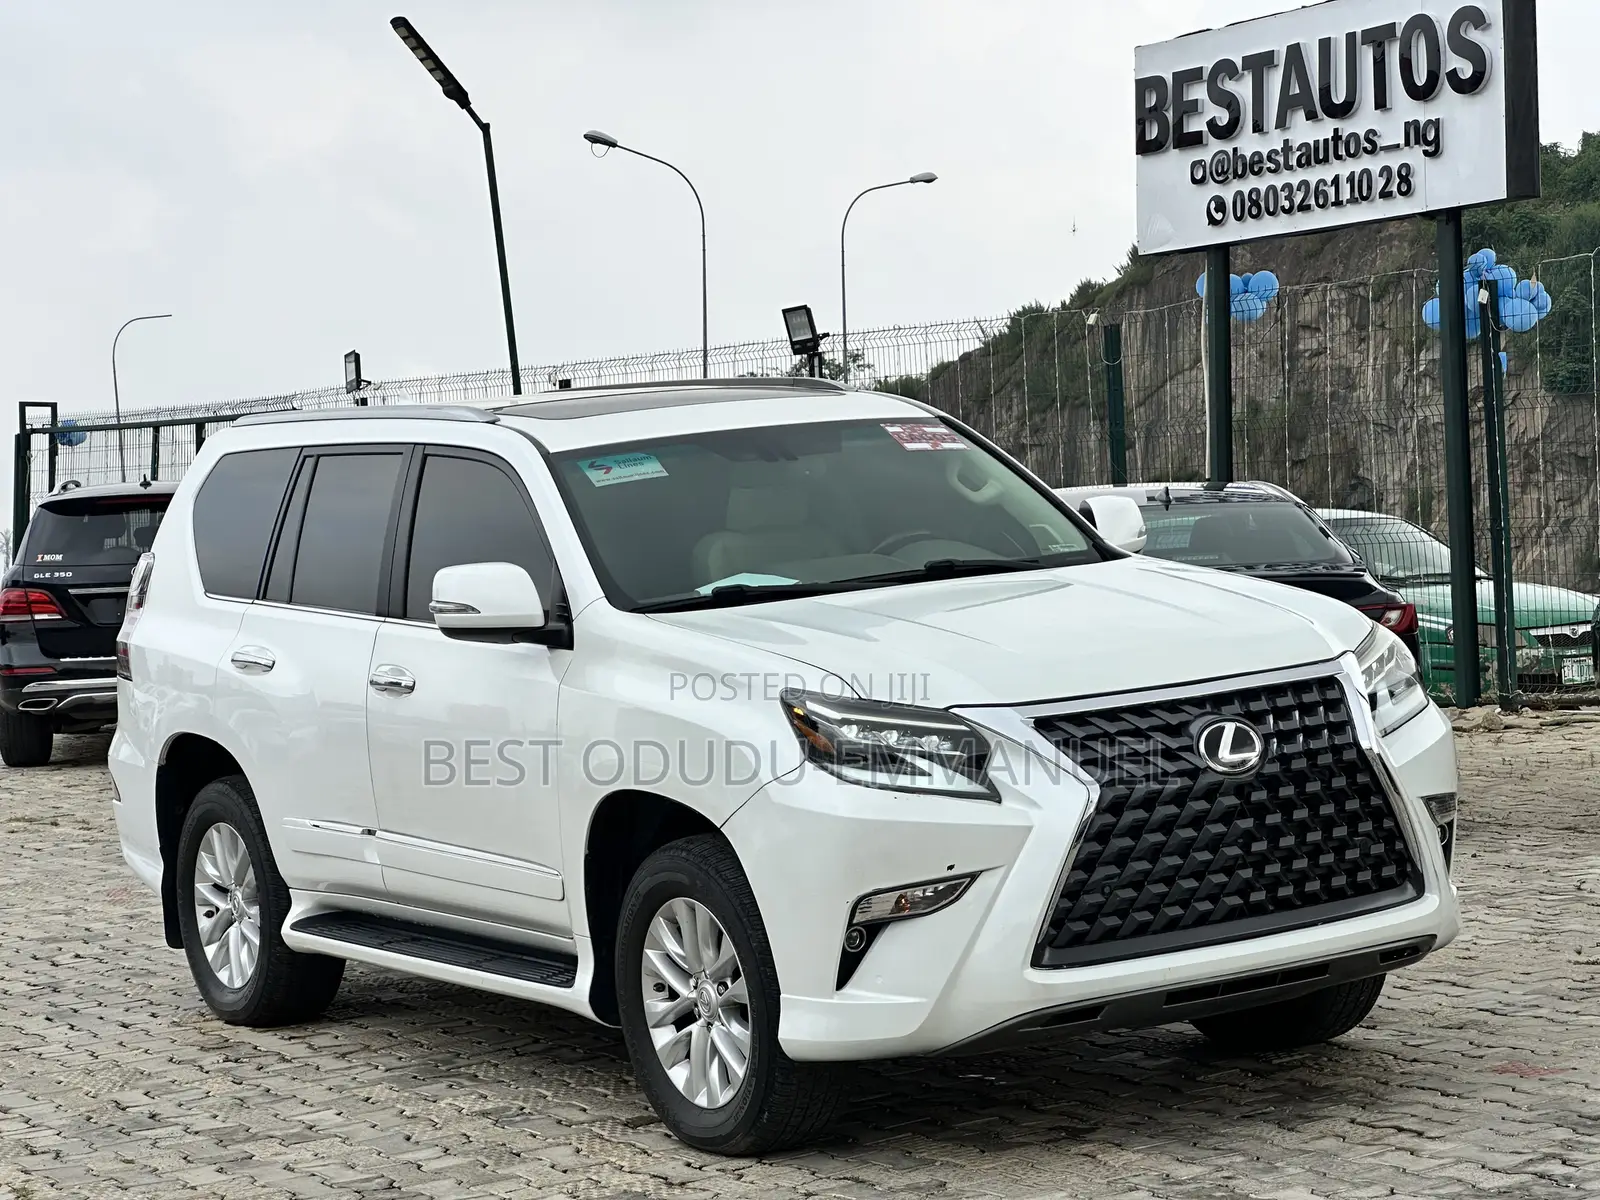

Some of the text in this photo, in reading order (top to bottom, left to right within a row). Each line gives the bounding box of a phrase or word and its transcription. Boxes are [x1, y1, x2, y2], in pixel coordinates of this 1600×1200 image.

[1136, 5, 1492, 155] BESTAUTOS
[1209, 117, 1444, 185] @bestautos_ng
[1232, 162, 1416, 222] 08032611028
[617, 461, 645, 470] Lines
[43, 553, 63, 561] MOM
